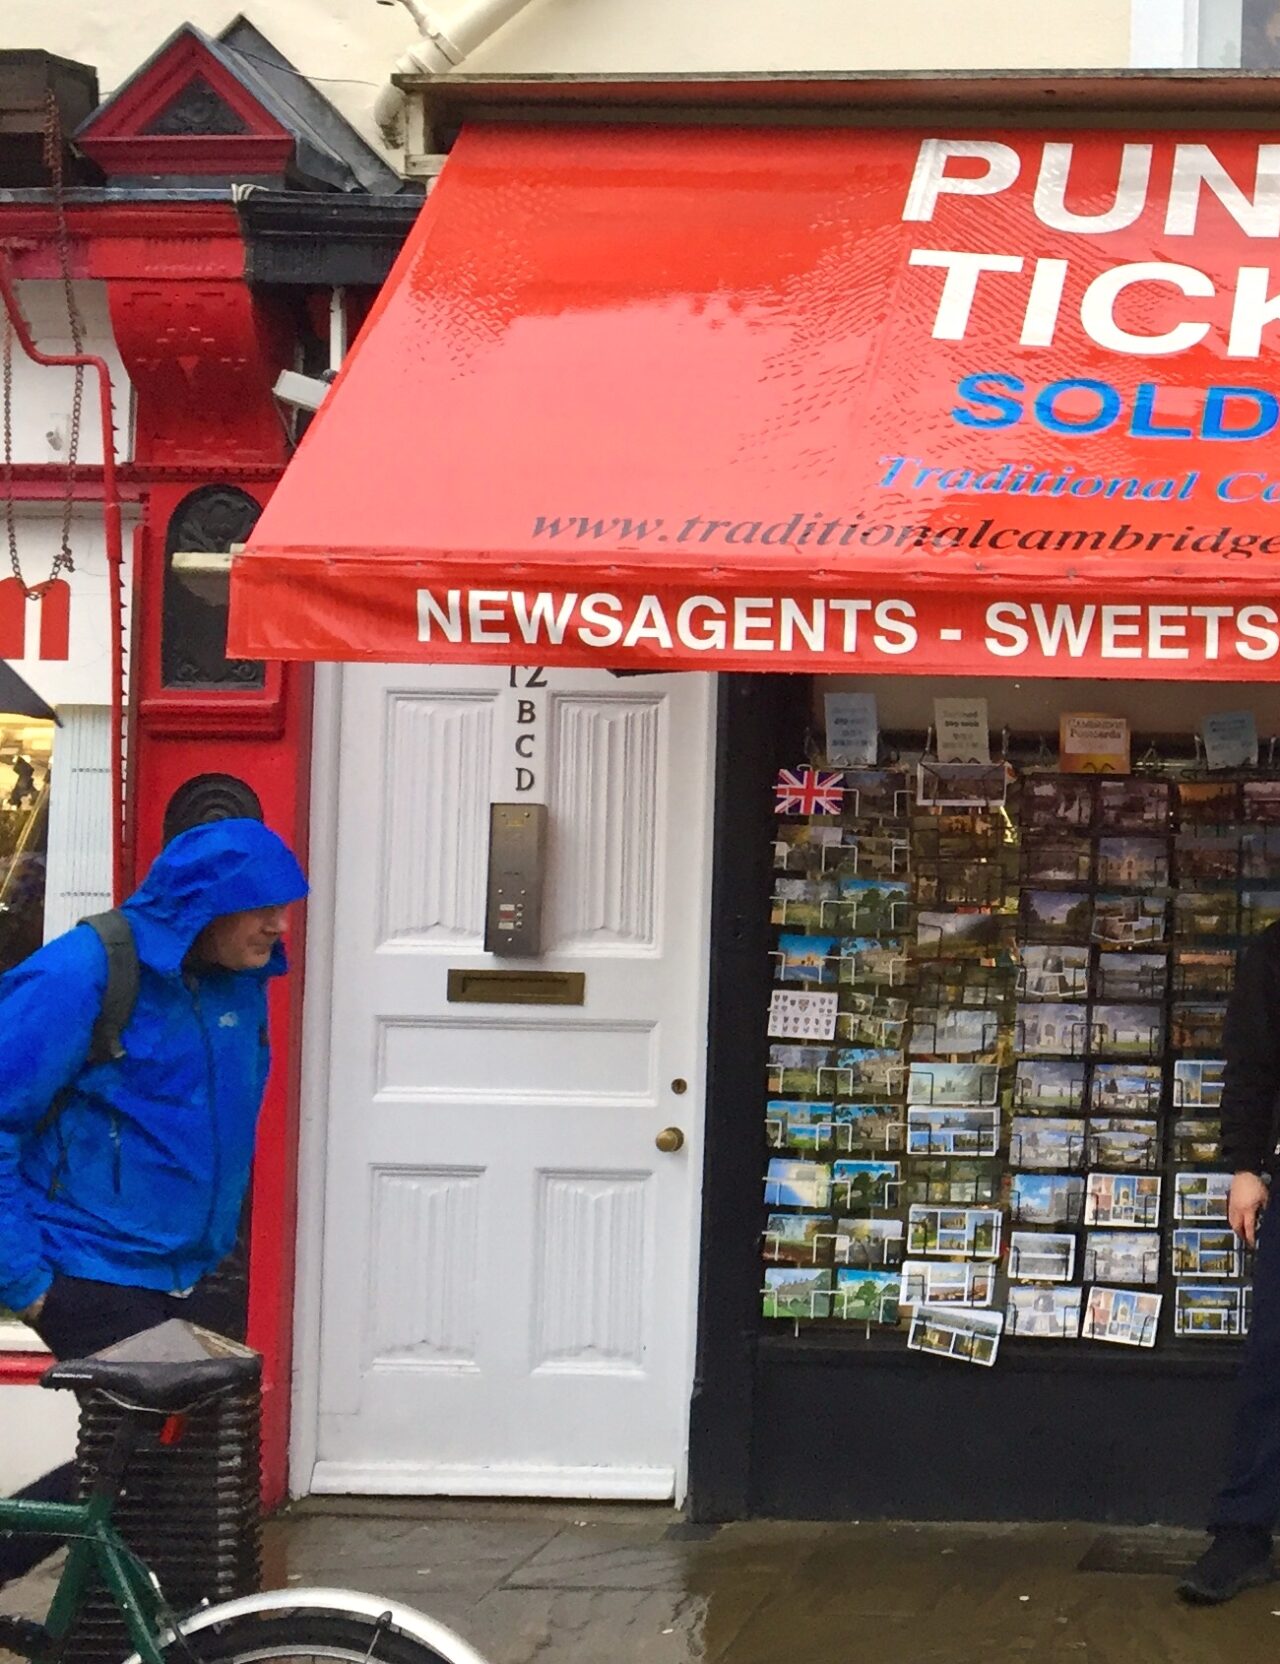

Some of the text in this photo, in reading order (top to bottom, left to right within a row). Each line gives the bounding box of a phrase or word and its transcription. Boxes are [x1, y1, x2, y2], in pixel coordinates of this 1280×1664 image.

[951, 372, 1280, 441] SOLD
[874, 454, 1201, 502] Traditional
[416, 588, 918, 654] NEWSAGENTS
[984, 602, 1280, 661] SWEETS
[517, 700, 536, 724] B
[515, 733, 535, 758] C
[515, 767, 535, 791] D
